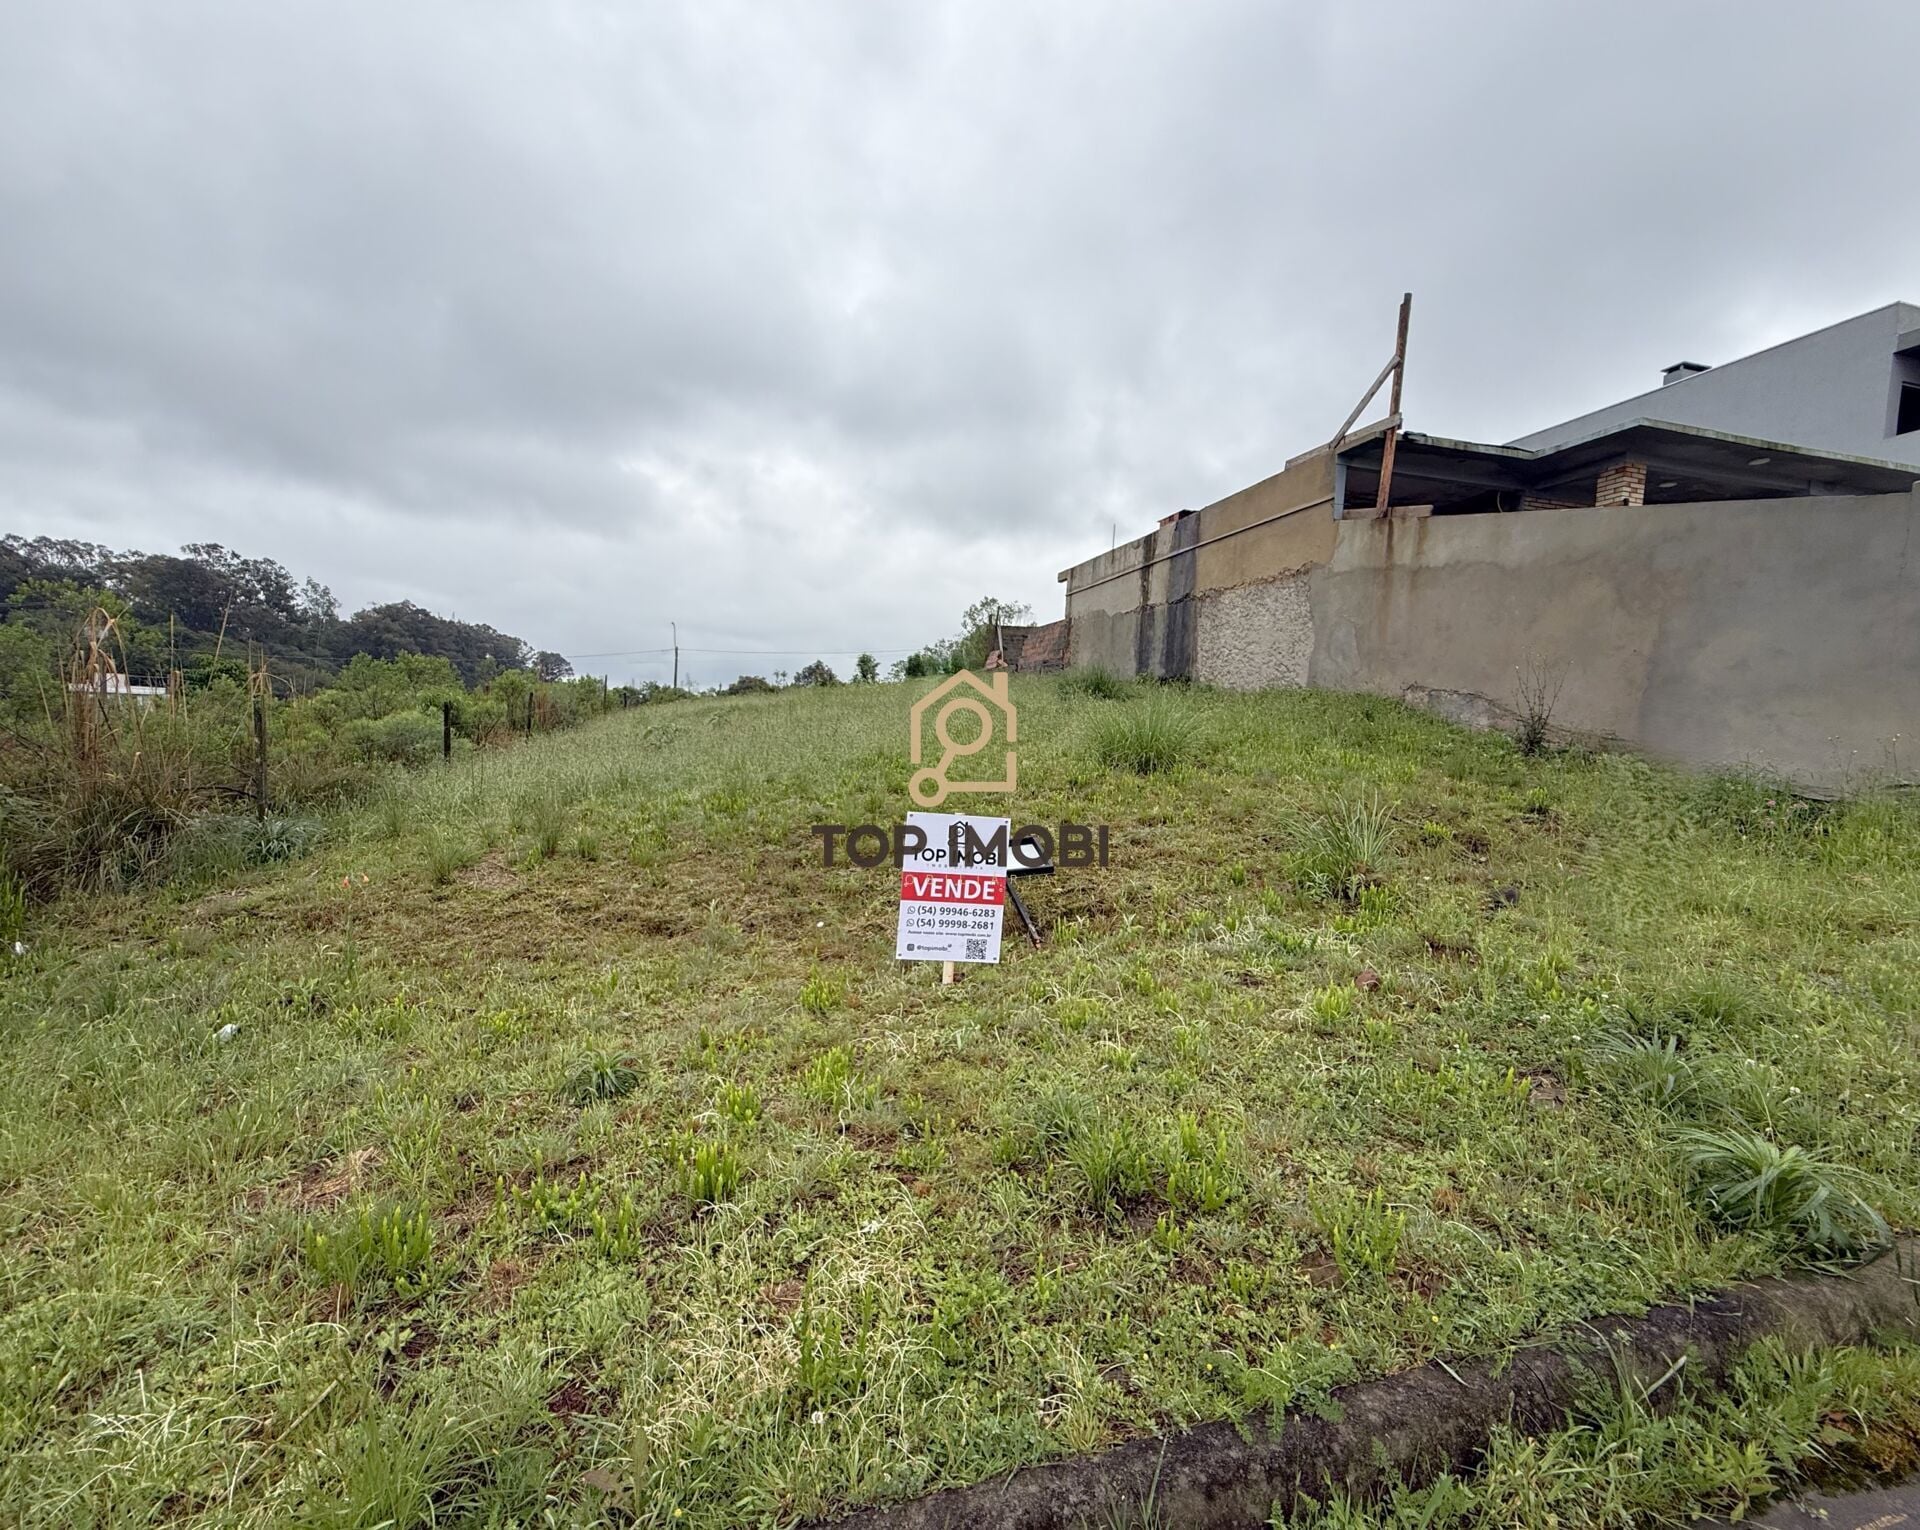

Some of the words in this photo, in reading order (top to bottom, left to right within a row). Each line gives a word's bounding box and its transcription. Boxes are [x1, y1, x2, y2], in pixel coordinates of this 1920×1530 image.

[912, 876, 996, 900] VENDE
[917, 905, 937, 916] (54)
[939, 906, 996, 918] 99946-6283
[916, 918, 936, 929] (54)
[938, 919, 994, 930] 99998-2681
